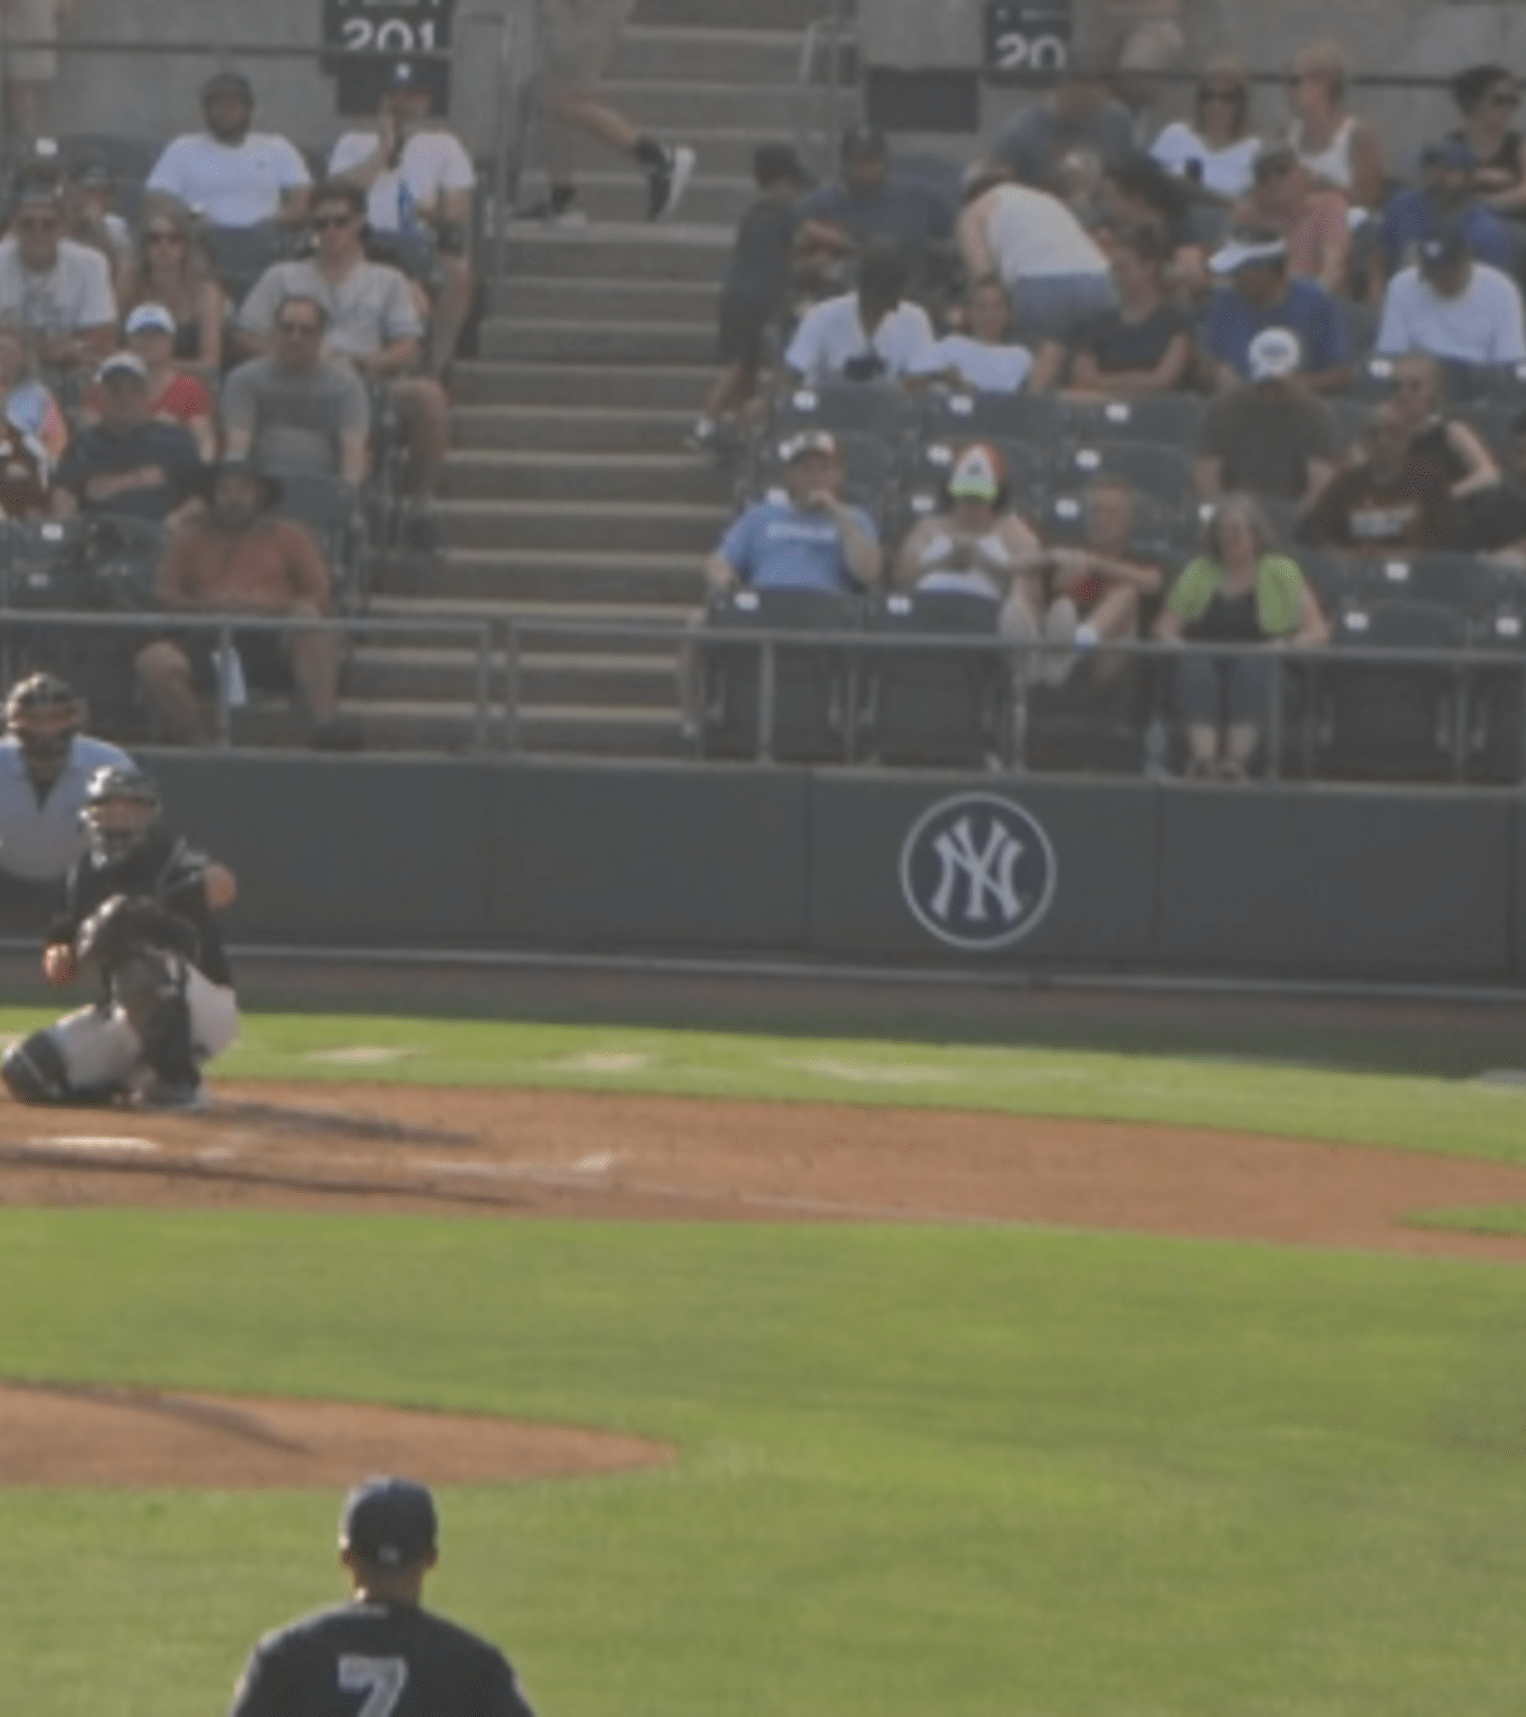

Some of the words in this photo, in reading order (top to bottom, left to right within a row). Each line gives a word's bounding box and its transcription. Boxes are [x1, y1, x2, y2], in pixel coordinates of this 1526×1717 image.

[341, 17, 435, 53] 201
[930, 815, 1025, 923] NY
[337, 1654, 410, 1717] 7
